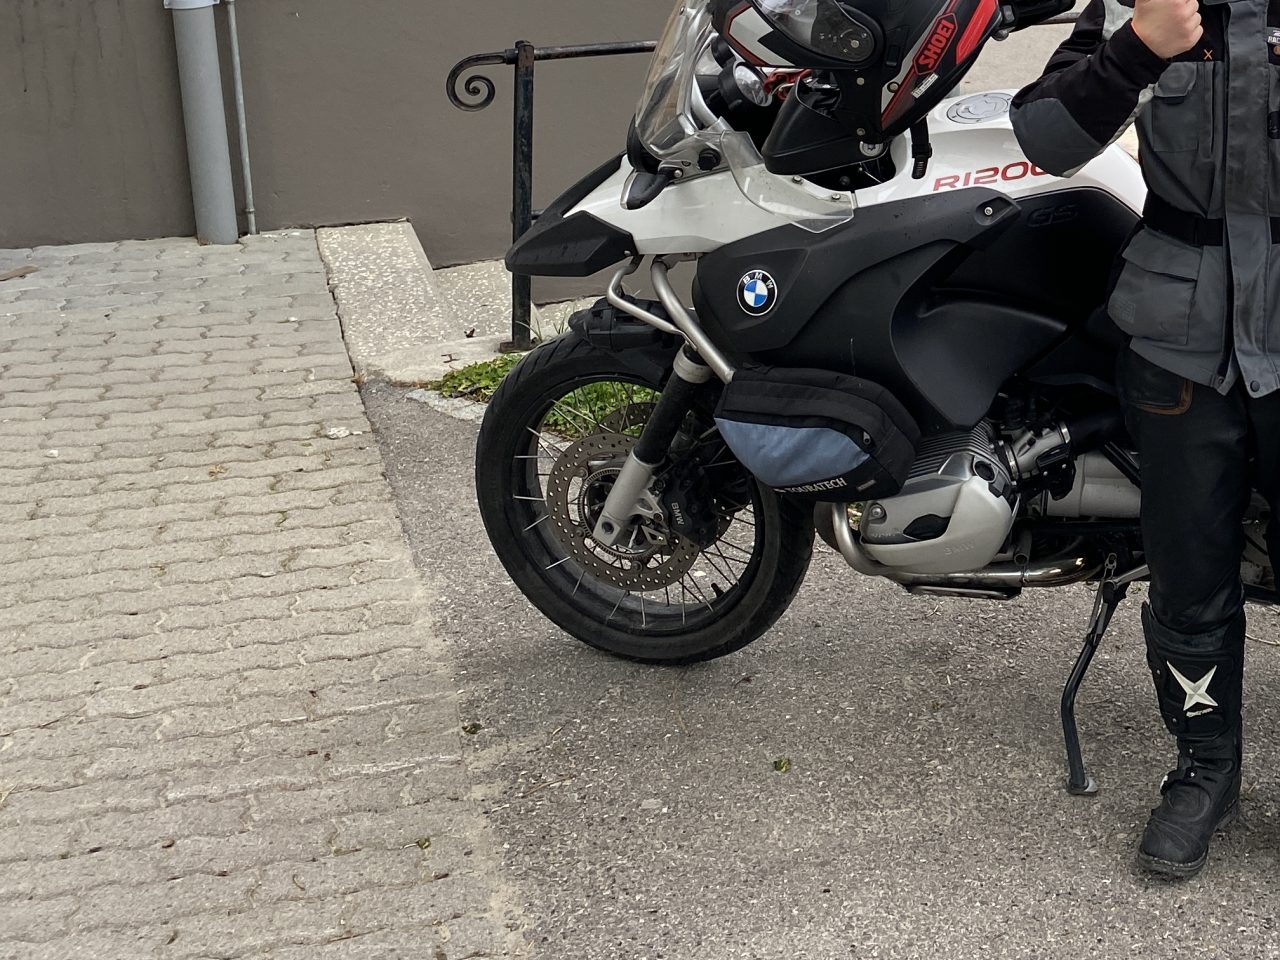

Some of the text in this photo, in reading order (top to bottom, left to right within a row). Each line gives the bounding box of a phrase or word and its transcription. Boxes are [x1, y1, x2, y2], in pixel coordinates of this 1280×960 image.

[918, 20, 955, 69] SHOEI
[742, 271, 774, 289] BMW
[671, 502, 685, 525] BMW
